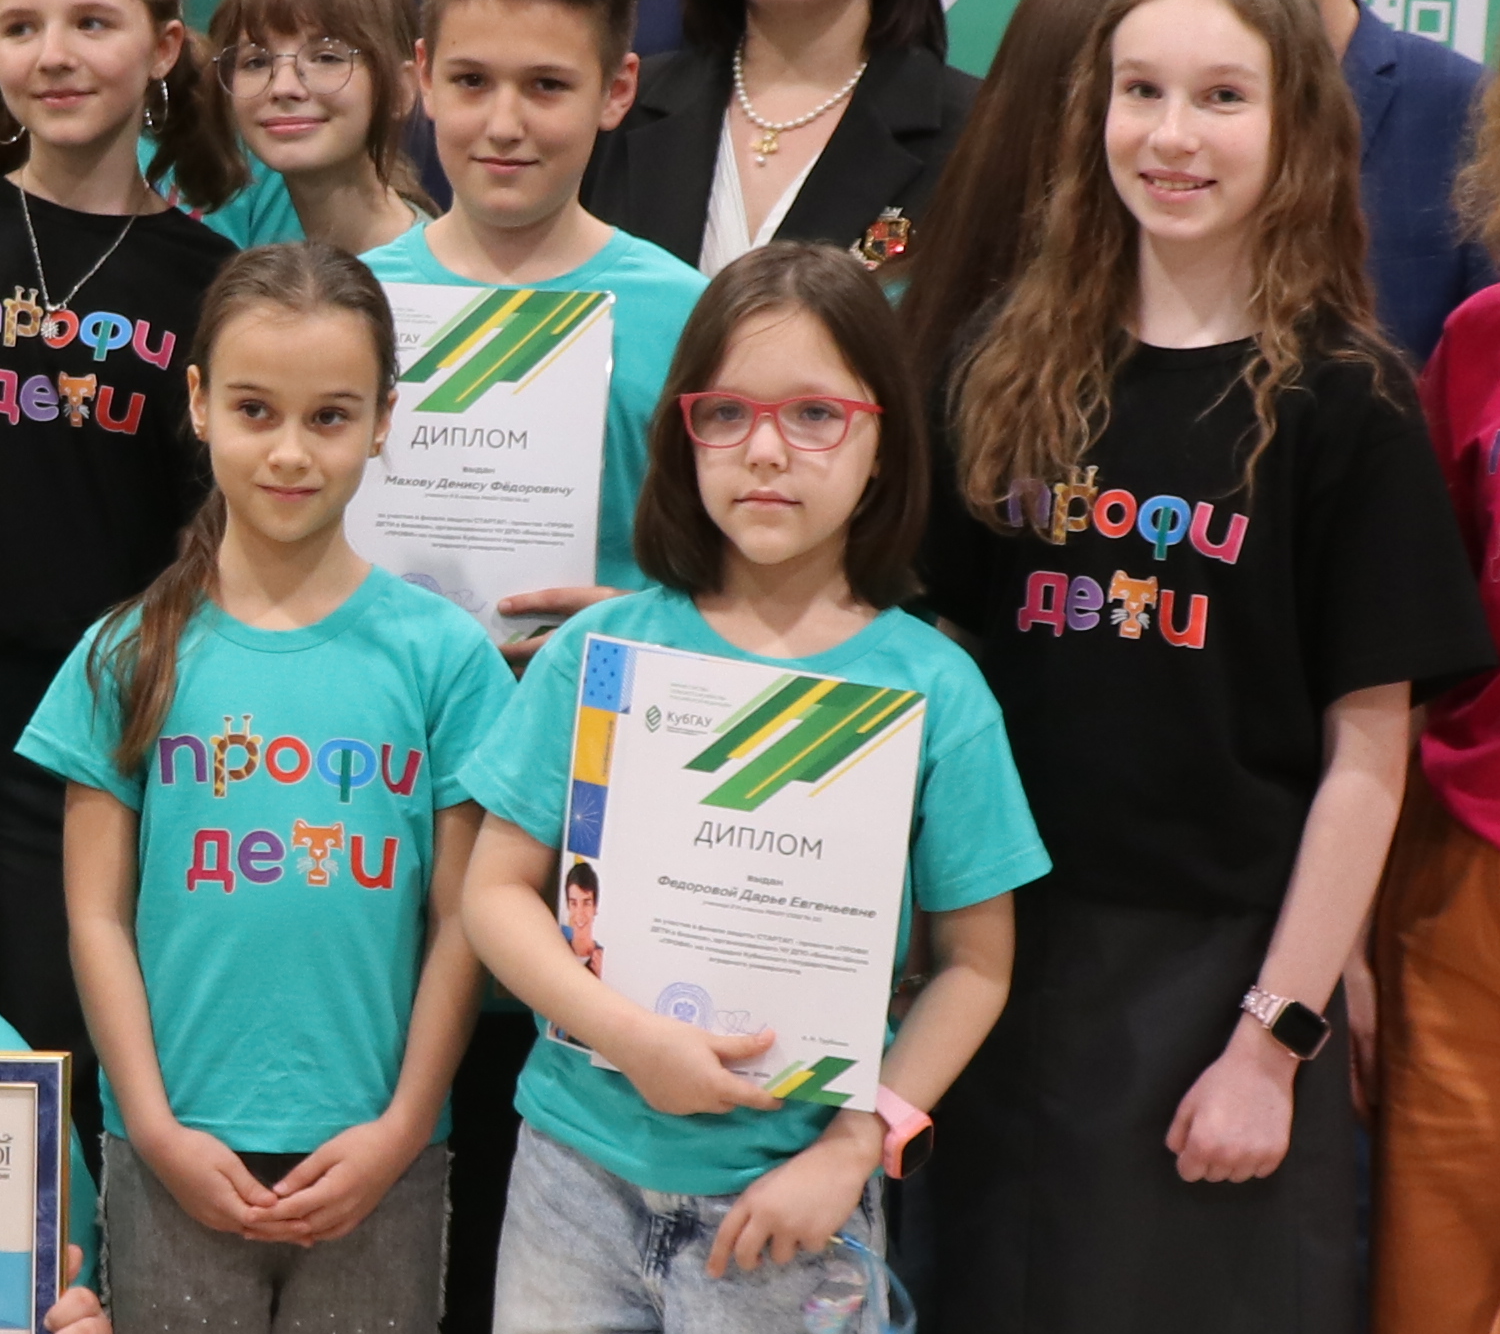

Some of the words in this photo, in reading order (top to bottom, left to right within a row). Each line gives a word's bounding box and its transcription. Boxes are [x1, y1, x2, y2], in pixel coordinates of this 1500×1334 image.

[396, 333, 421, 344] ГАУ
[410, 425, 528, 450] ДИПЛОМ
[384, 474, 437, 490] Махову
[434, 477, 489, 493] Денису
[490, 480, 575, 498] Фёдоровичу
[666, 711, 713, 728] КубГАУ
[693, 820, 824, 861] ДИПЛОМ
[657, 874, 738, 899] Федоровой
[738, 889, 788, 907] Дарье
[788, 896, 878, 919] Евгеньевне
